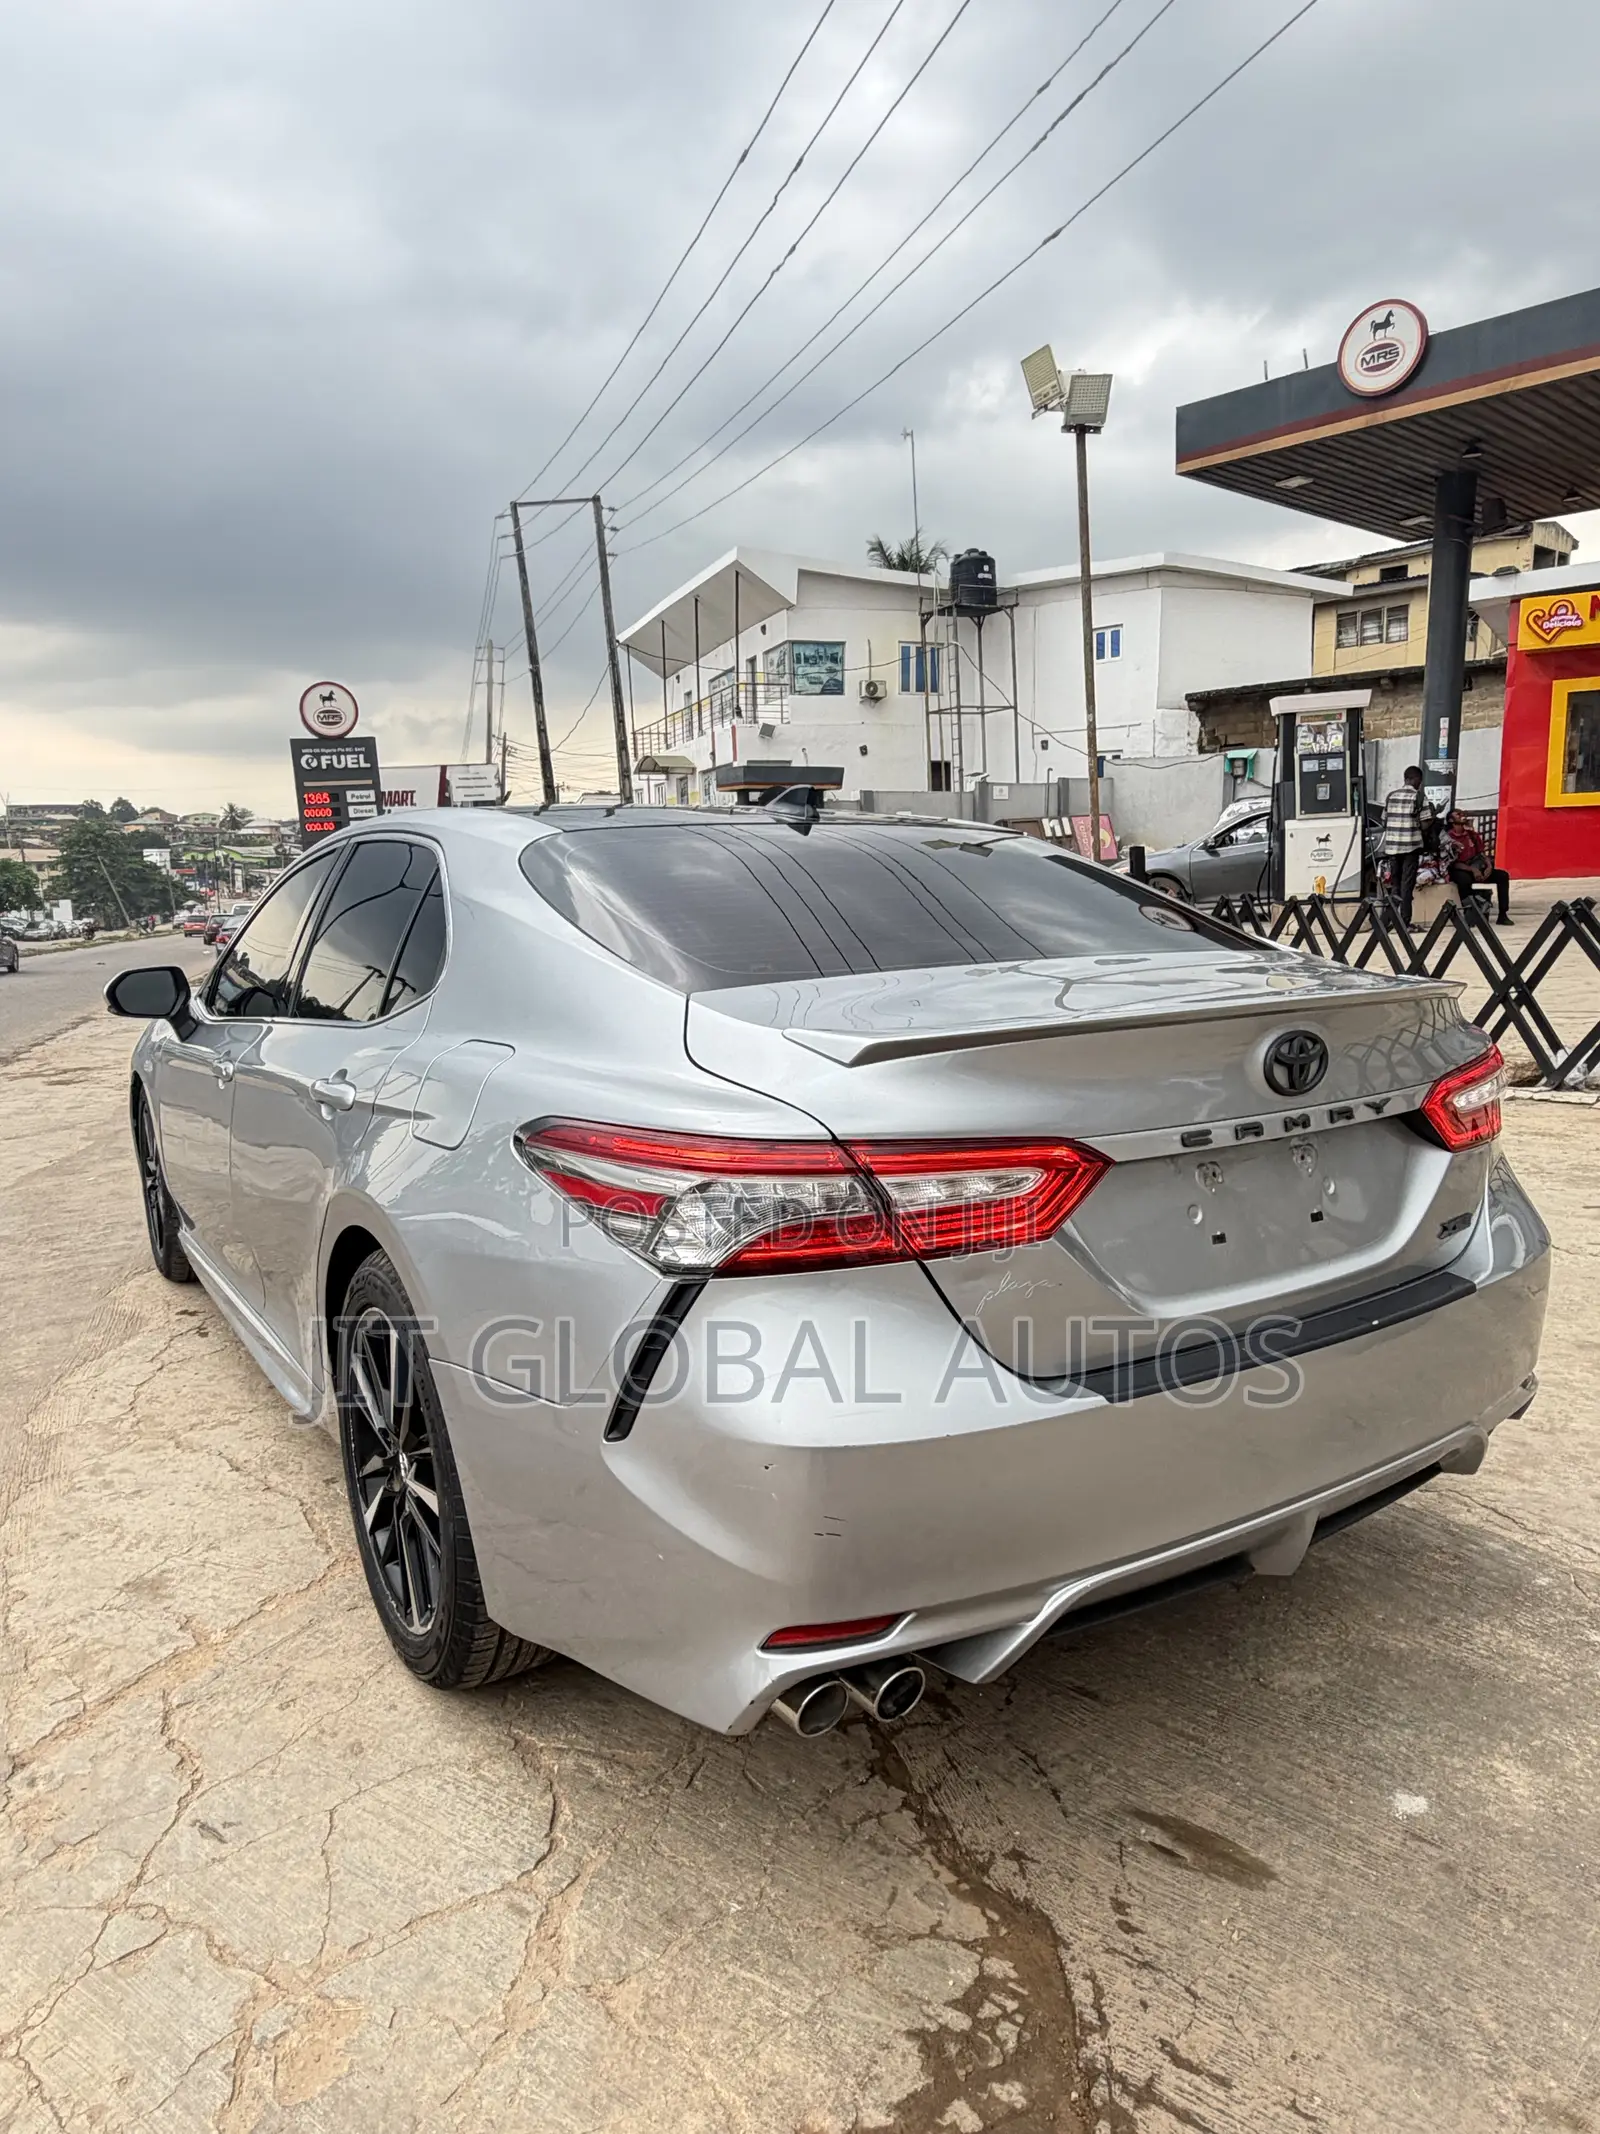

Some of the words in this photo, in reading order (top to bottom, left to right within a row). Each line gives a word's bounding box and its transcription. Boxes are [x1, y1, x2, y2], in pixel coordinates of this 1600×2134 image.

[1360, 346, 1400, 368] MRS
[1542, 619, 1582, 630] Delicious
[320, 753, 371, 769] FUEL
[351, 793, 371, 801] Petrol
[353, 806, 374, 814] Diesel
[1181, 1096, 1392, 1147] CAMRY
